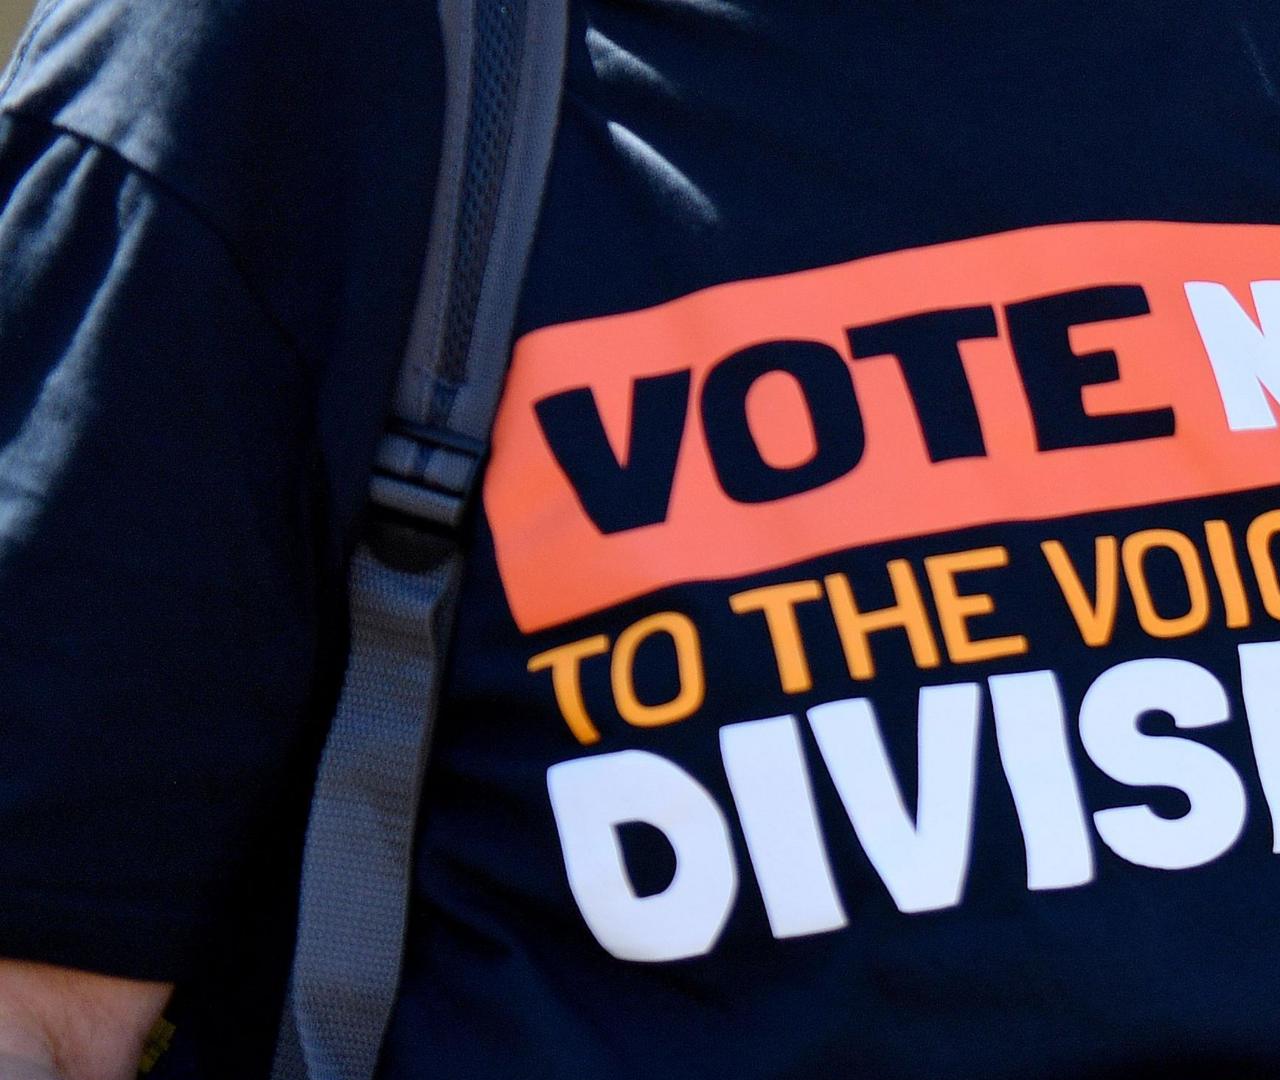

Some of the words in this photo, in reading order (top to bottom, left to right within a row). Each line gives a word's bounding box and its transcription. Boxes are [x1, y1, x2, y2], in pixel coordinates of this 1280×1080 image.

[532, 283, 1176, 534] VOTE
[526, 610, 706, 746] TO
[730, 546, 1028, 694] THE
